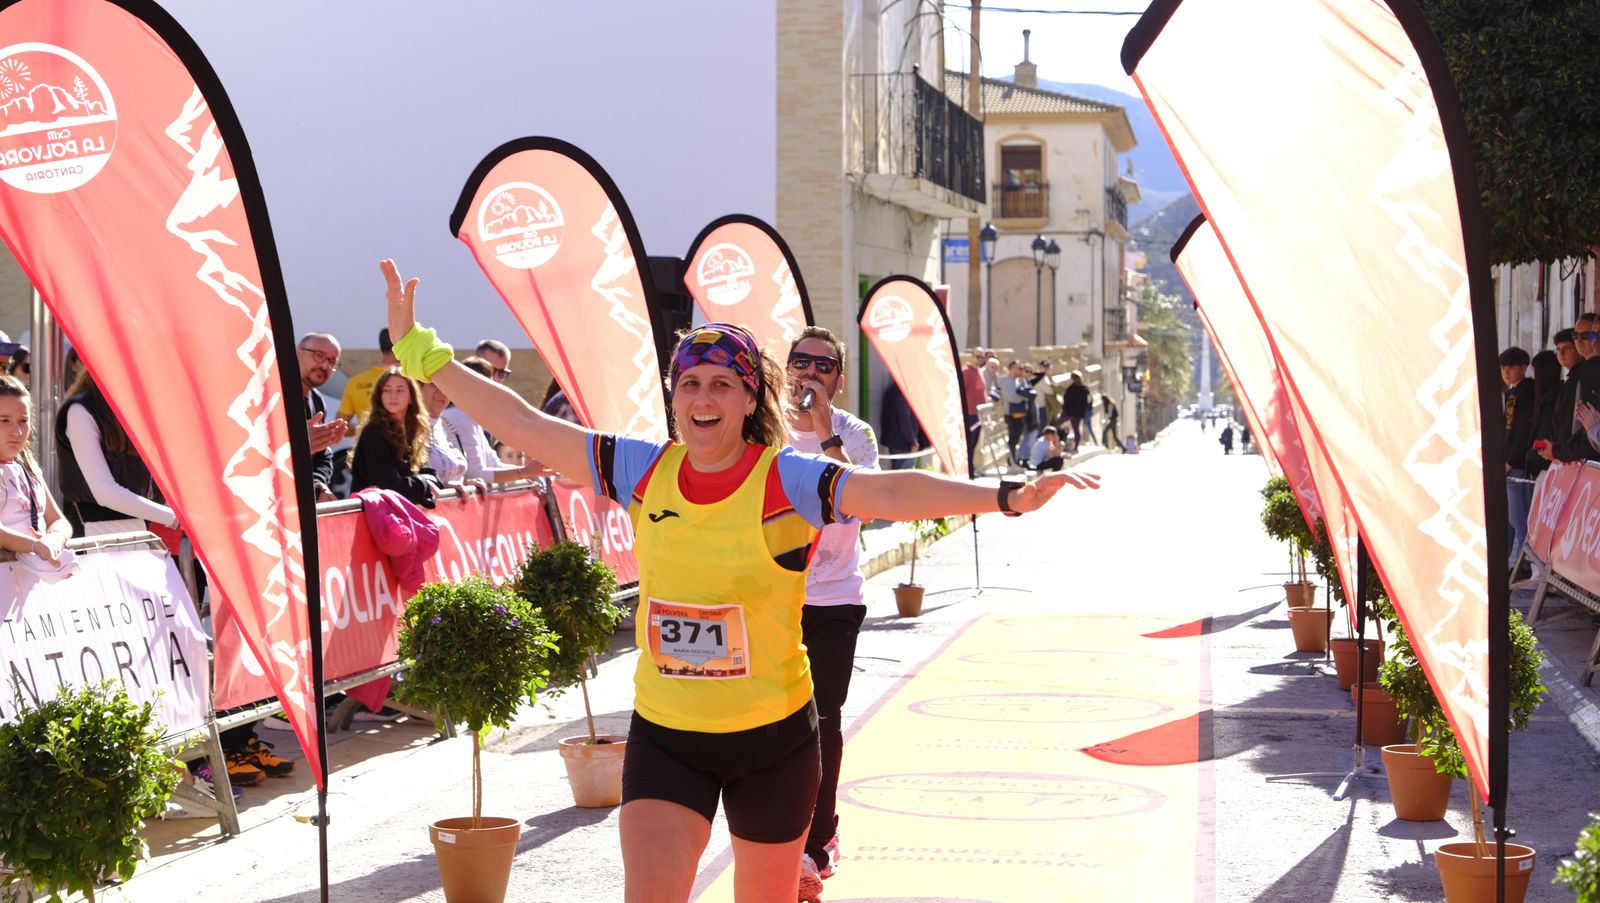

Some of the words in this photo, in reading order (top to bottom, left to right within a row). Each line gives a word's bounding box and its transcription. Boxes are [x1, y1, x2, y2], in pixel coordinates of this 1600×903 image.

[4, 602, 133, 644] TAMIENTO
[142, 595, 175, 622] DE
[661, 619, 723, 647] 371
[0, 631, 191, 718] NTORIA
